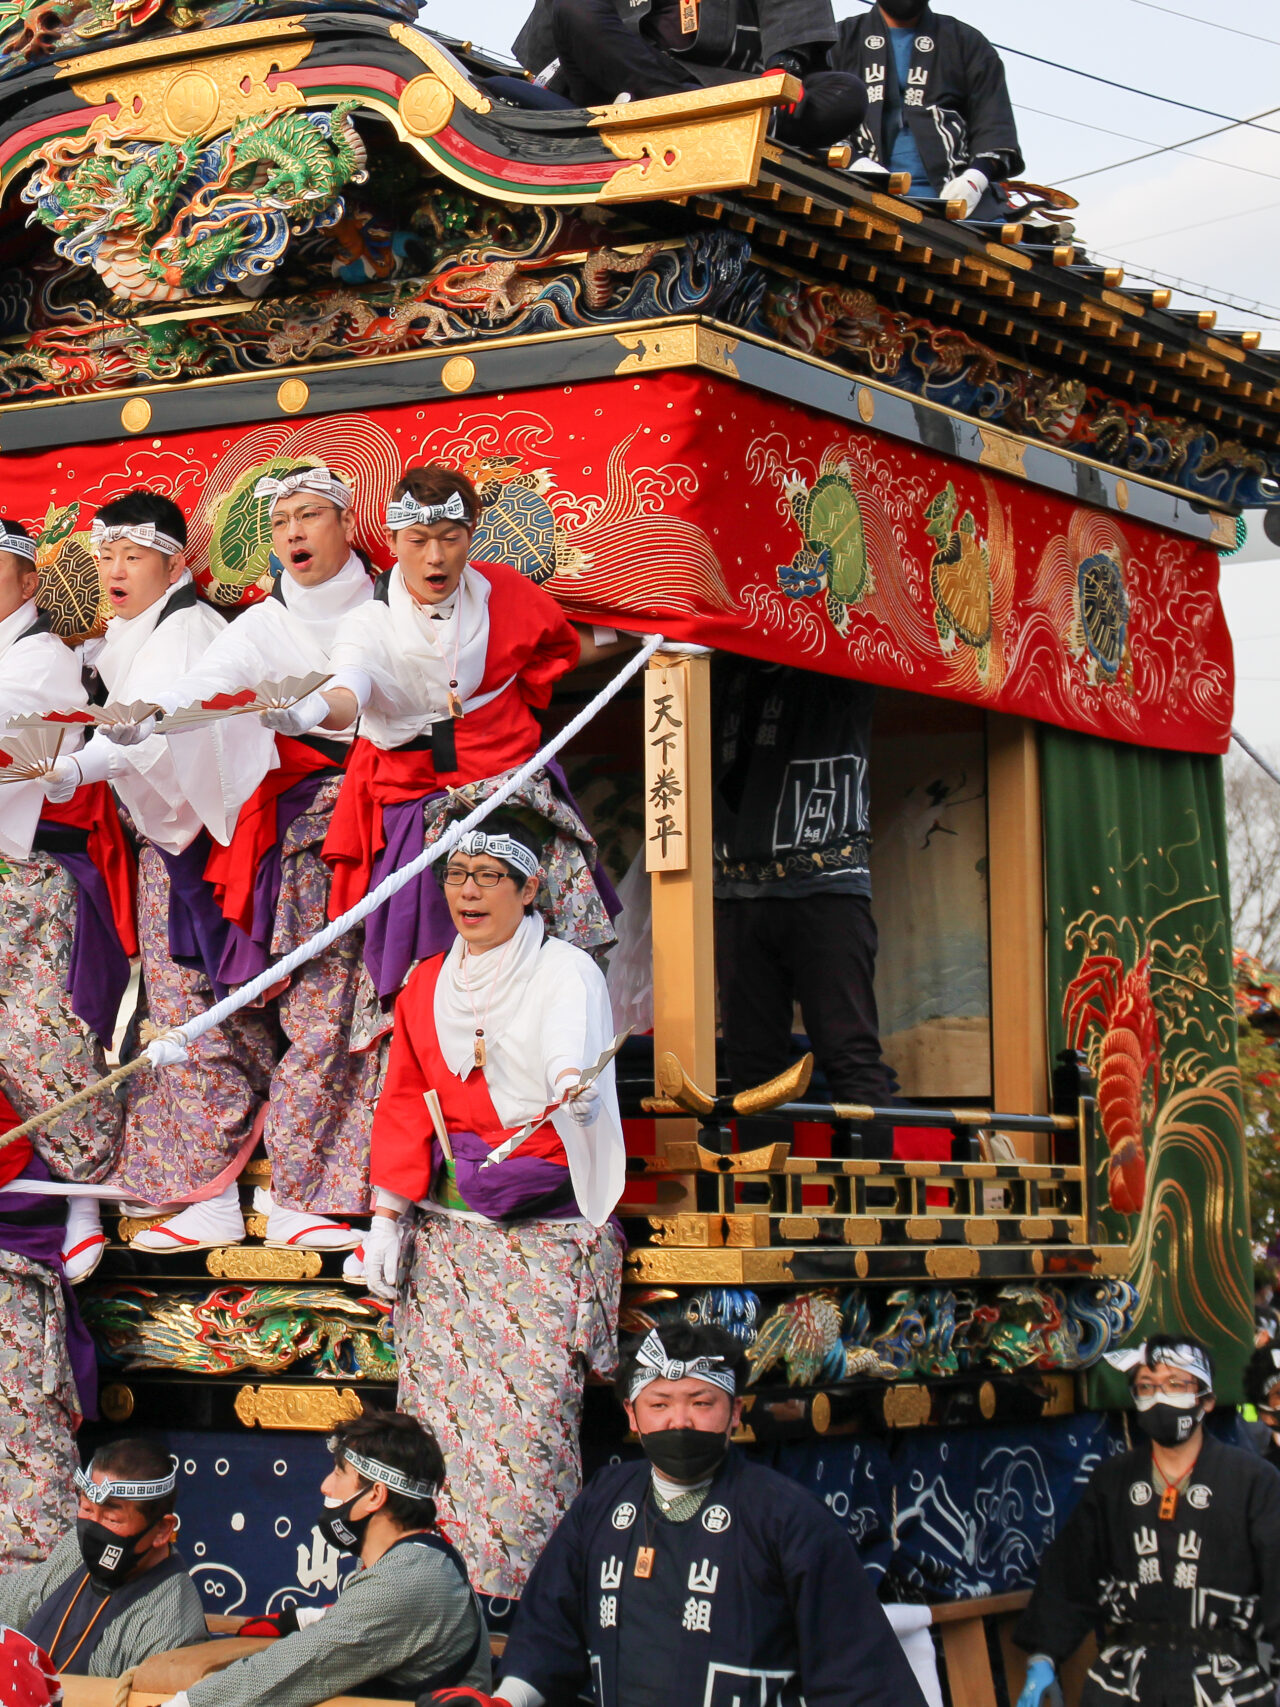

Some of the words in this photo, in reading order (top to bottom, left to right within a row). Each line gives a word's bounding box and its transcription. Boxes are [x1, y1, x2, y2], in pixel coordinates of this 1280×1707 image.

[865, 63, 885, 104] 山組
[904, 66, 929, 107] 山組
[648, 693, 684, 860] 天下泰平
[296, 1524, 340, 1591] 山
[1132, 1525, 1163, 1585] 山組
[1173, 1529, 1202, 1590] 山組
[600, 1555, 624, 1629] 山組
[681, 1557, 720, 1634] 山組
